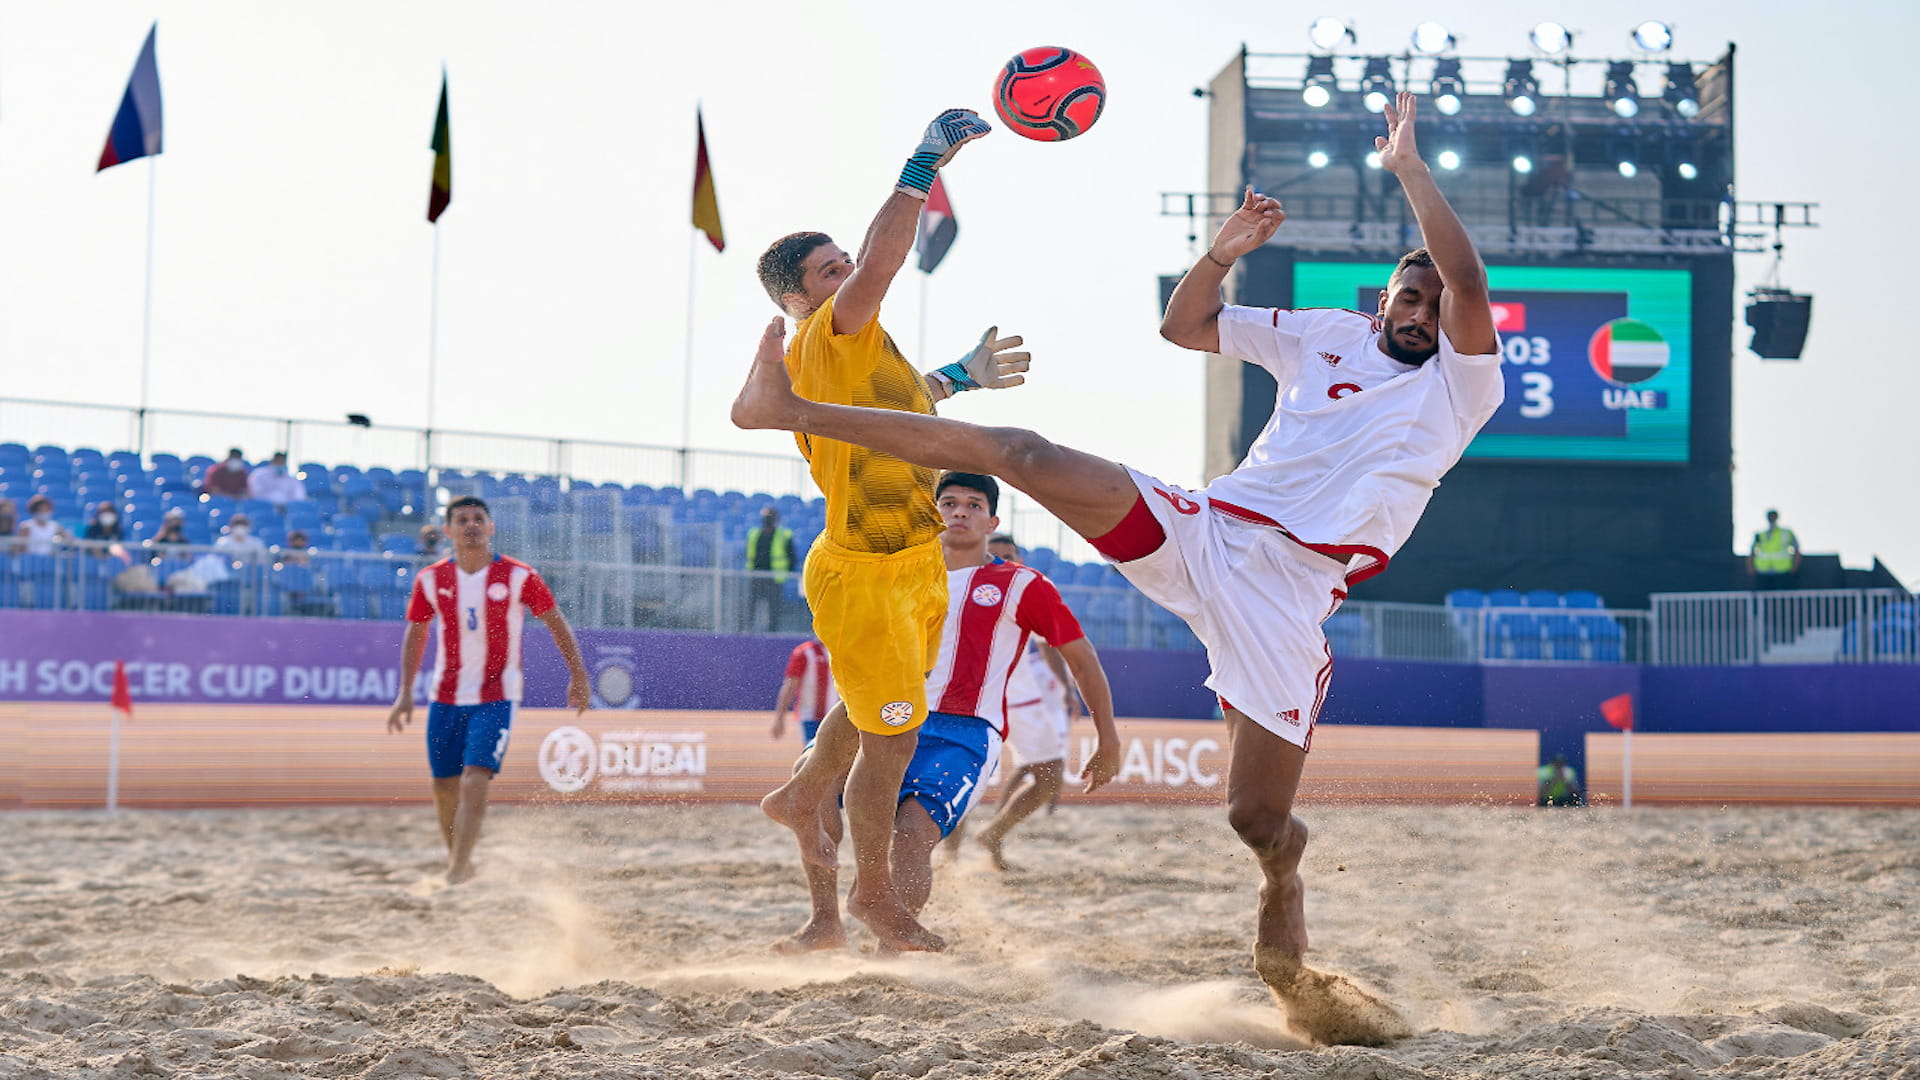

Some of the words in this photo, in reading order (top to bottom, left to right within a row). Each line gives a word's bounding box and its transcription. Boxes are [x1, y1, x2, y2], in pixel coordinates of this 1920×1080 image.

[1519, 371, 1555, 419] 3
[1602, 388, 1657, 410] UAE
[36, 659, 192, 698] SOCCER
[199, 662, 277, 698] CUP
[283, 664, 398, 700] DUBAI
[600, 741, 707, 777] DUBAI
